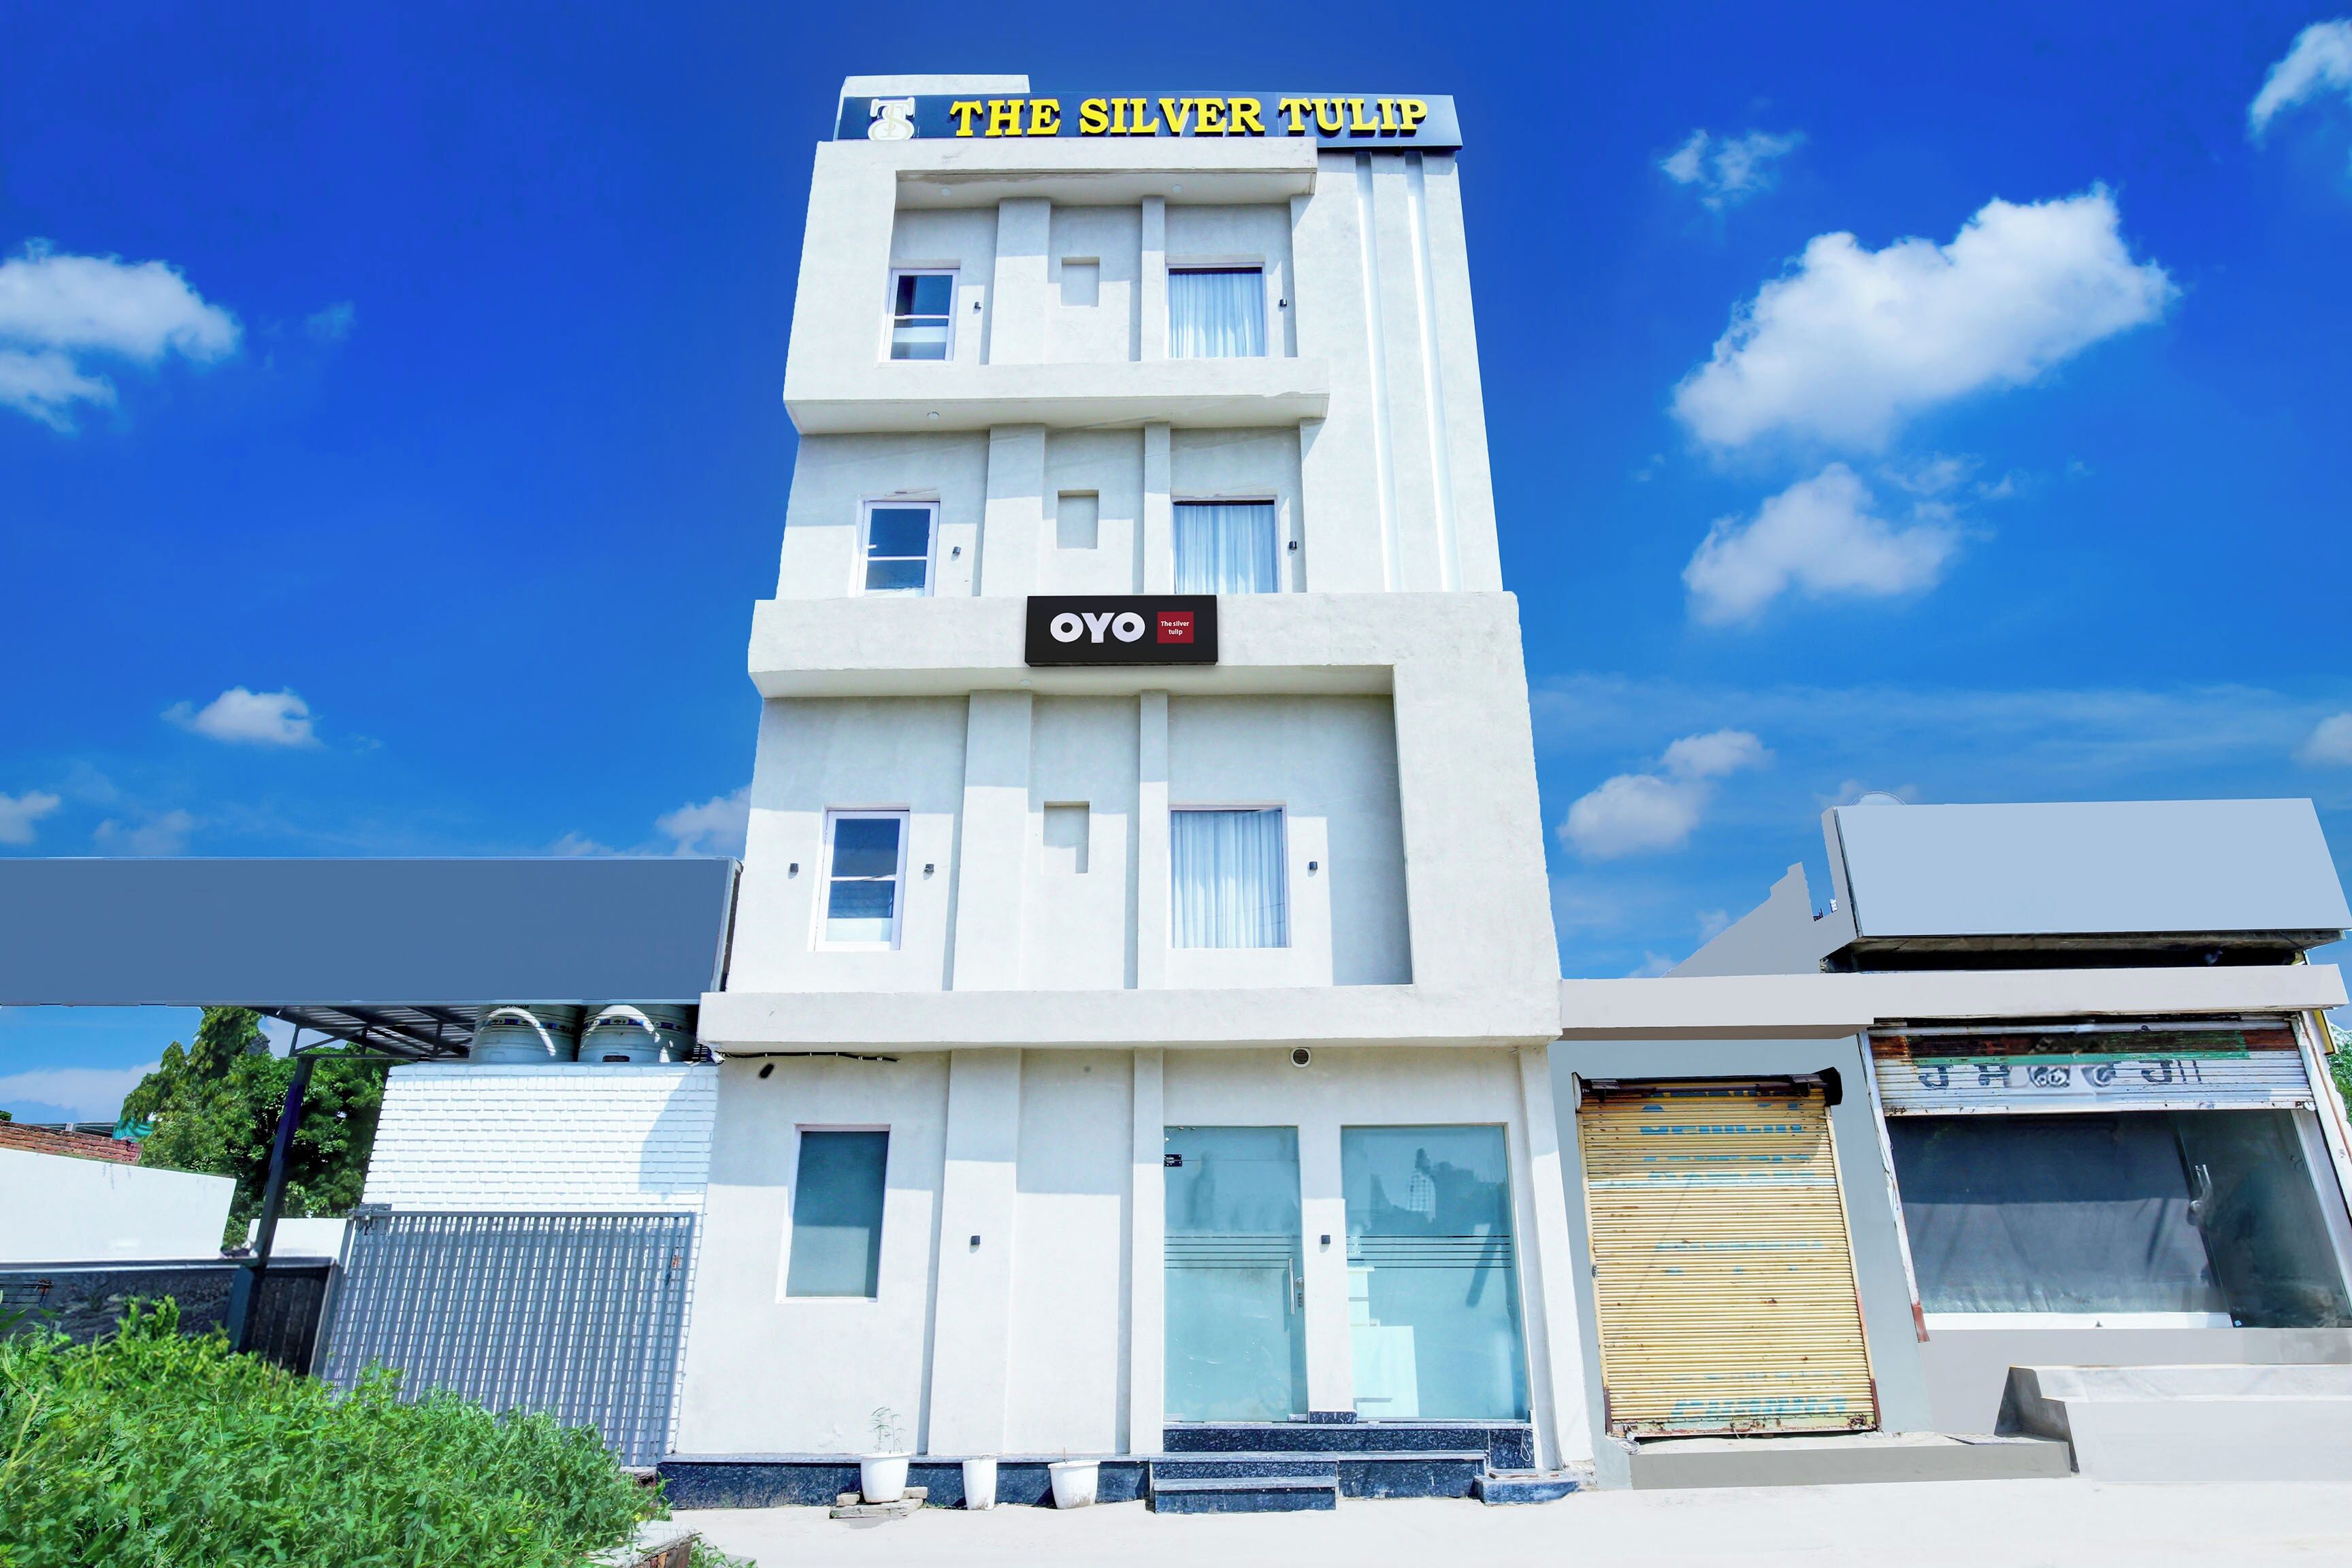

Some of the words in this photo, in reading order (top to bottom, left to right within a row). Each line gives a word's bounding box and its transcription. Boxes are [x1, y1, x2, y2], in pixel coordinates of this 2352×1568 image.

[949, 98, 1061, 137] THE
[1079, 97, 1266, 135] SILVER
[1278, 97, 1428, 134] TULIP
[1049, 612, 1146, 643] OYO
